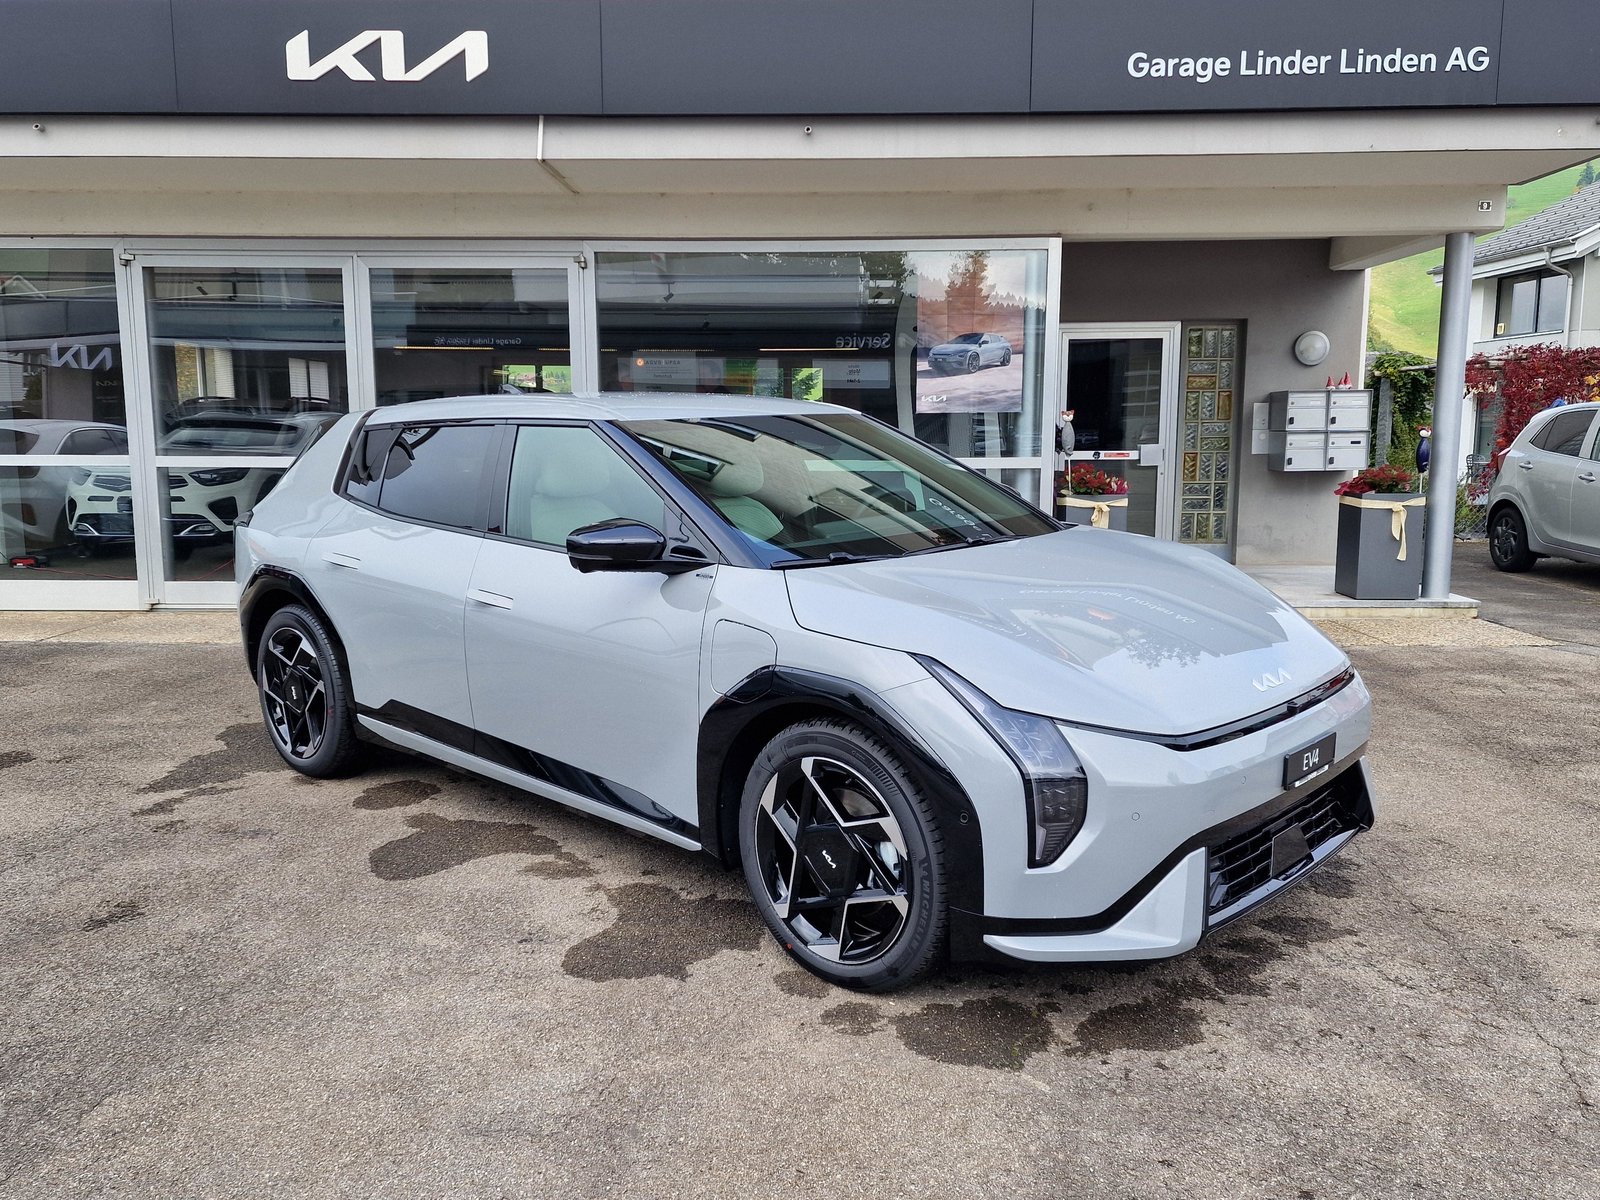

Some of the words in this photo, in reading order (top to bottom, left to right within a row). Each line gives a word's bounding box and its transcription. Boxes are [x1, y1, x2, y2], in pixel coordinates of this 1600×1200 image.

[286, 29, 489, 82] KIA
[1127, 52, 1231, 82] Garage
[1239, 50, 1331, 76] Linder
[1339, 48, 1437, 74] Linden
[1445, 46, 1490, 72] AG
[921, 394, 947, 402] KIA
[1252, 667, 1292, 692] KIA
[1303, 748, 1320, 771] EV4
